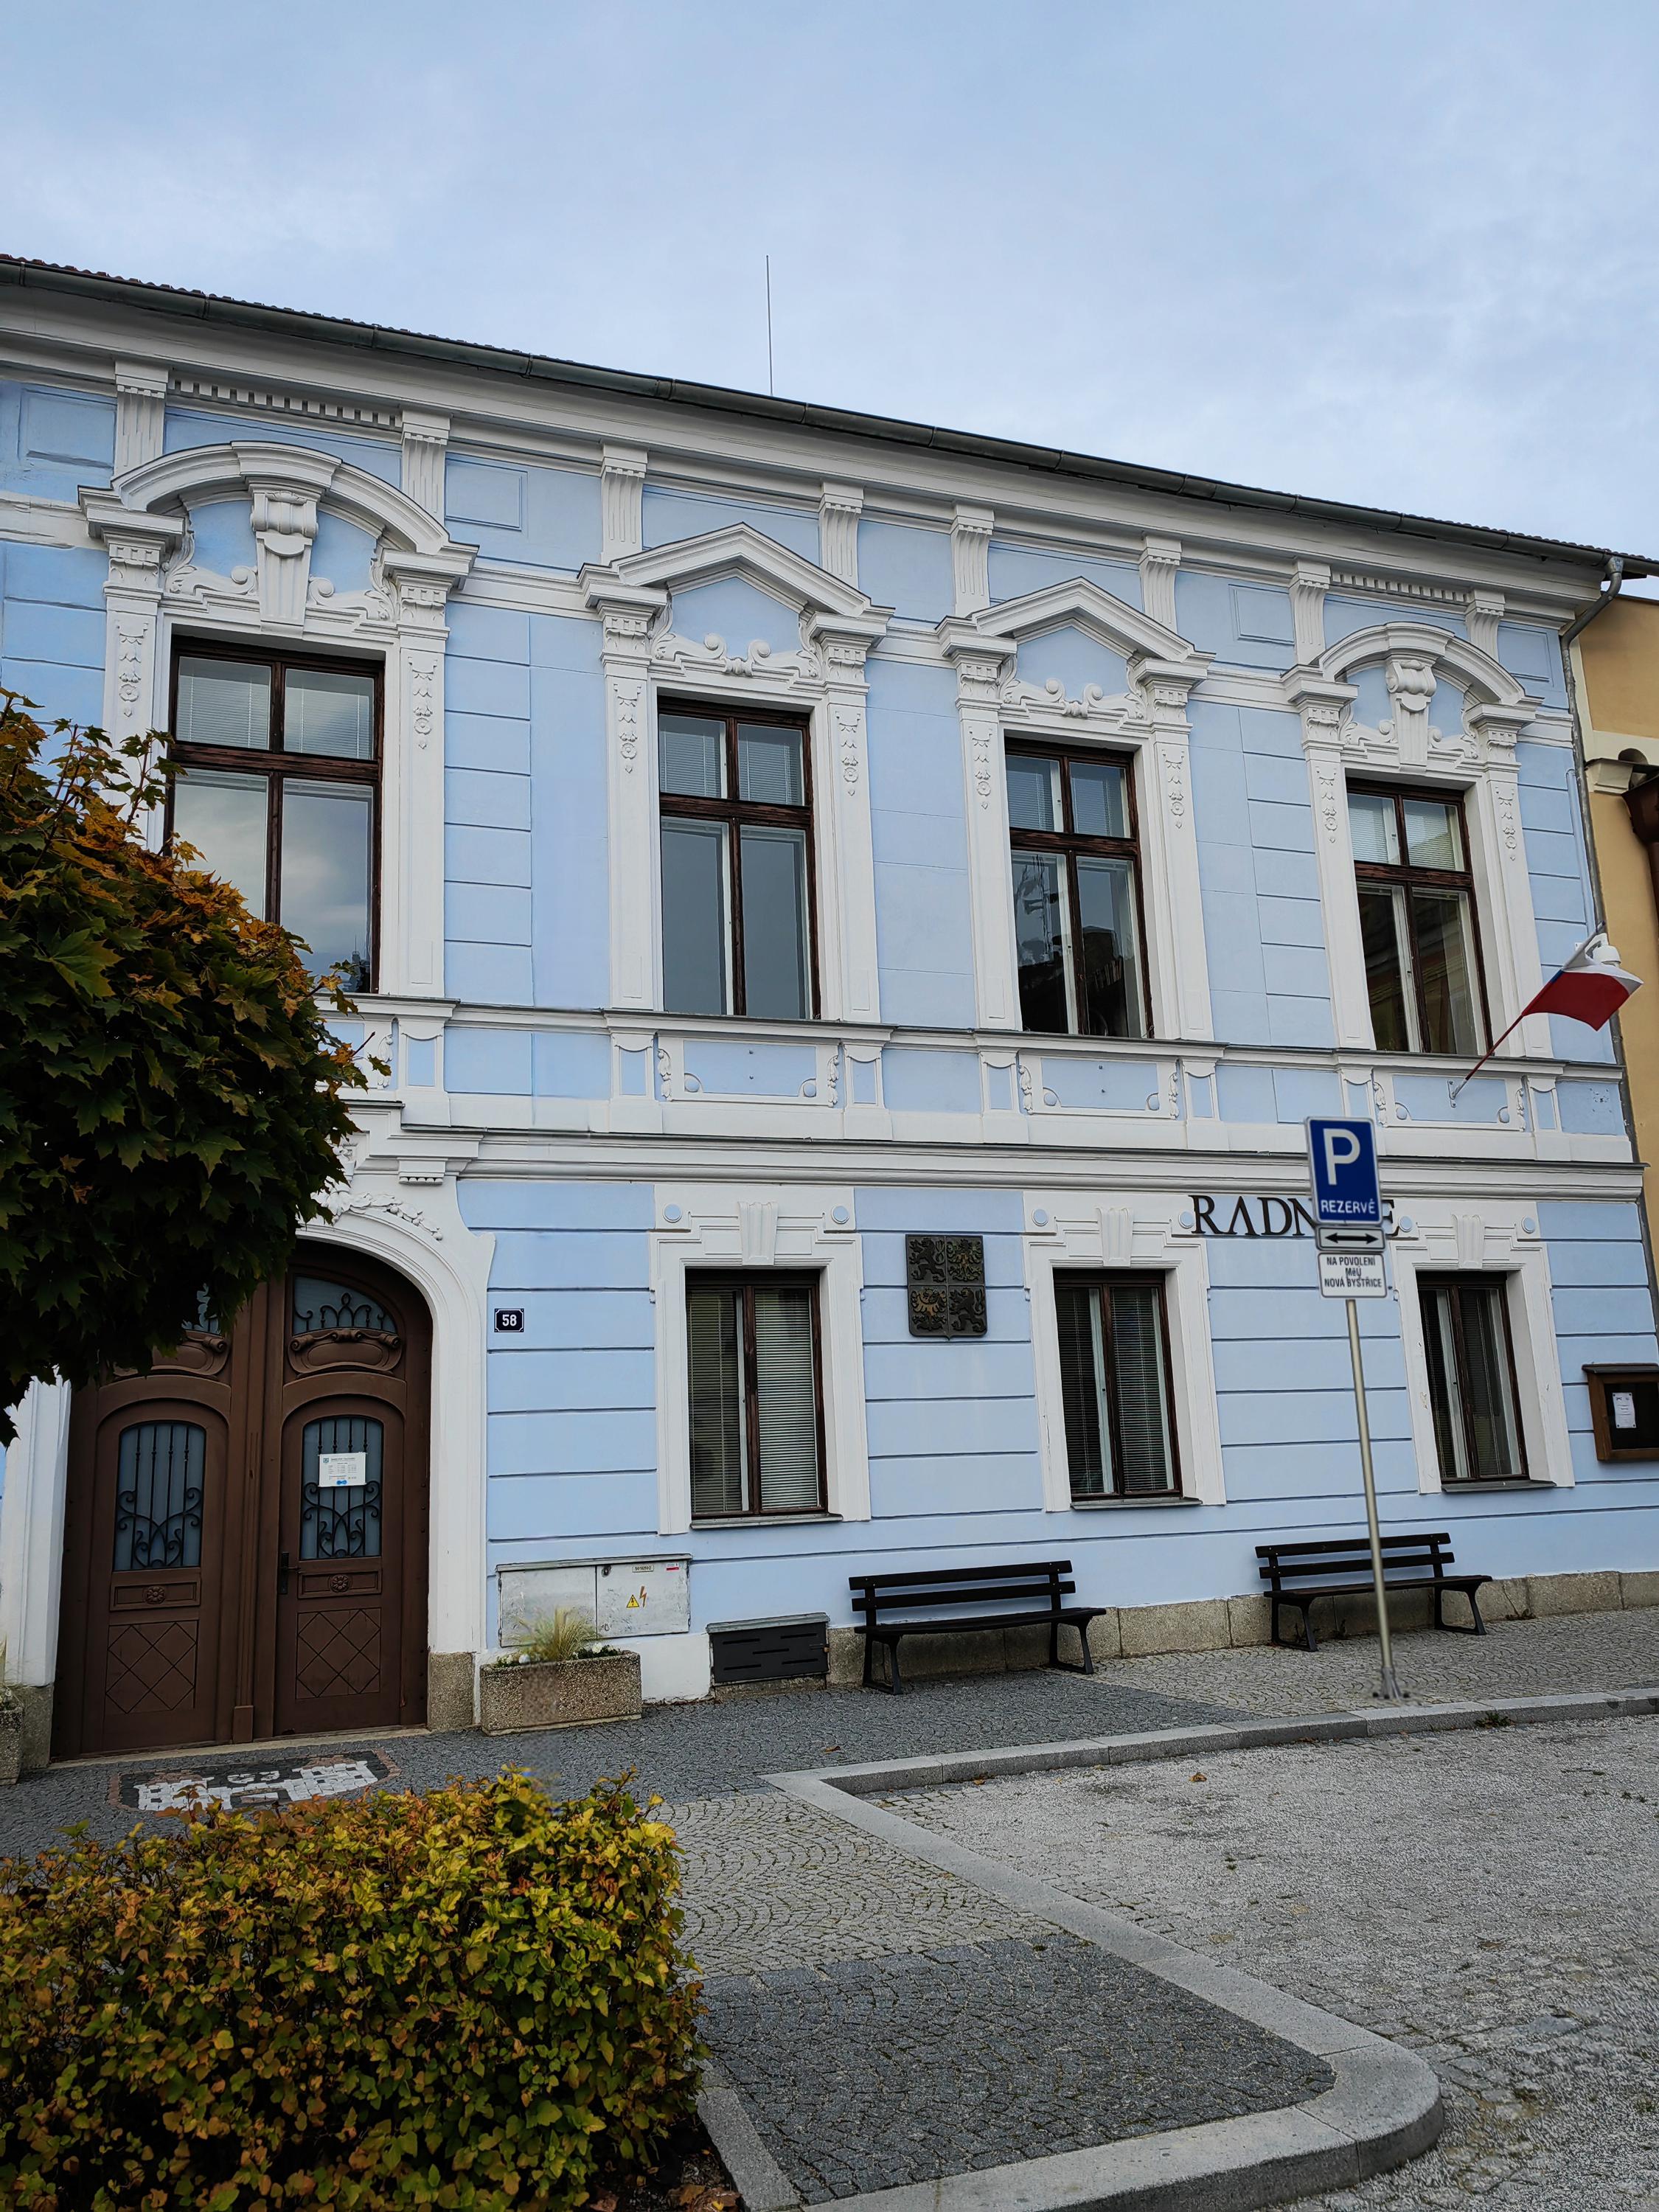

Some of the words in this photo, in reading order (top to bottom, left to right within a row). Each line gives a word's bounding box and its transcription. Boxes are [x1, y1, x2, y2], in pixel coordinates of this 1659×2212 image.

[1322, 1127, 1361, 1186] P
[1321, 1198, 1377, 1214] REZERVÉ
[1188, 1194, 1399, 1237] RADNE
[1326, 1256, 1338, 1266] NA
[1339, 1255, 1376, 1266] POVOLENÍ
[1324, 1276, 1345, 1287] NOVÁ
[1346, 1276, 1382, 1288] BYSTŘICE
[502, 1314, 517, 1326] 58
